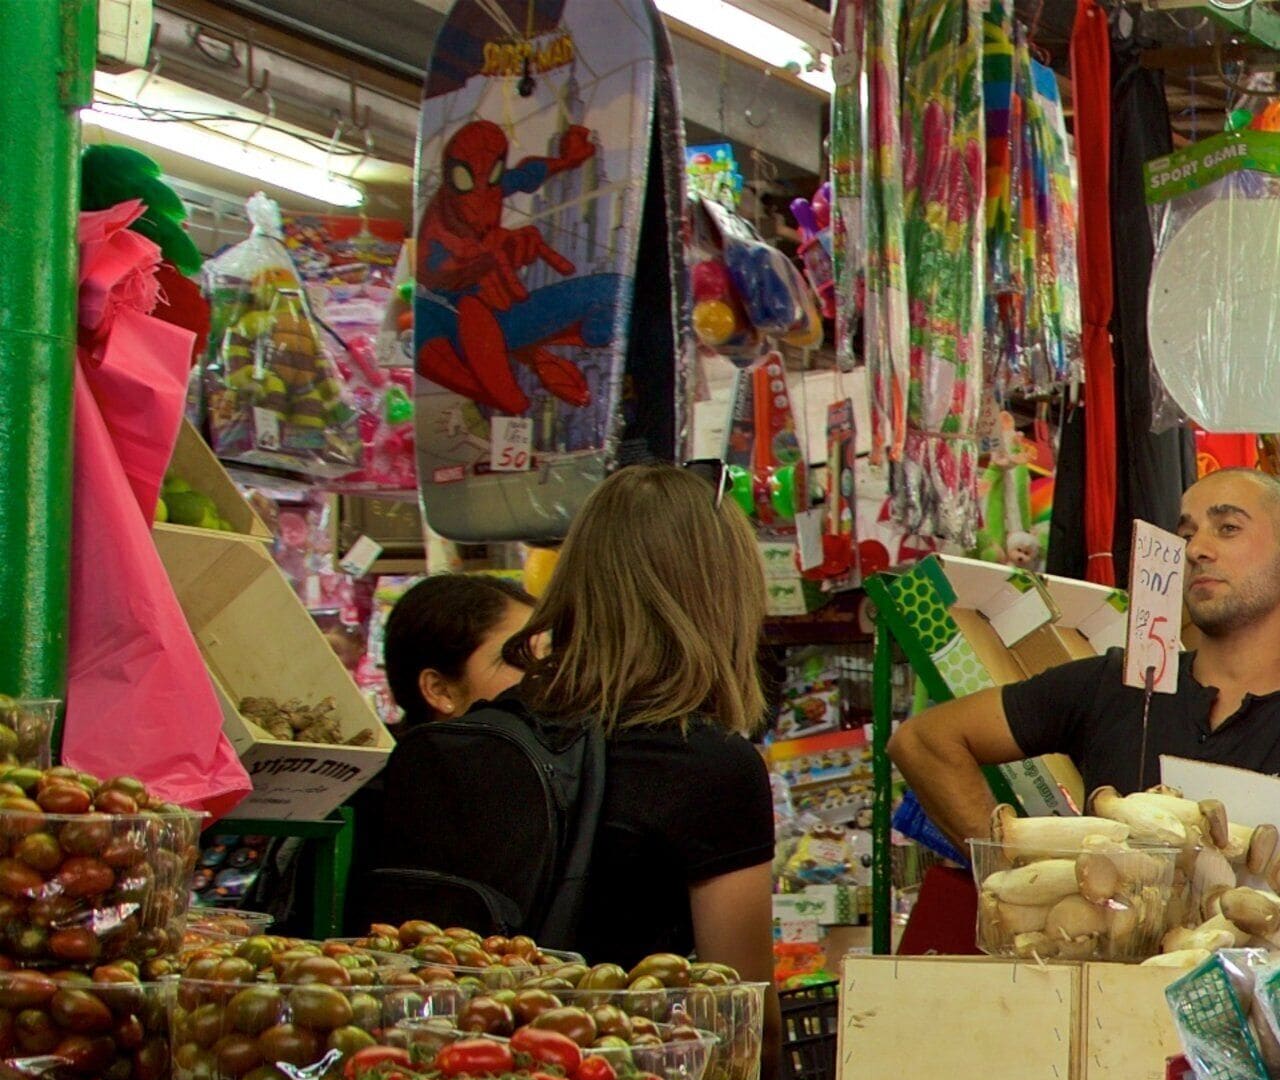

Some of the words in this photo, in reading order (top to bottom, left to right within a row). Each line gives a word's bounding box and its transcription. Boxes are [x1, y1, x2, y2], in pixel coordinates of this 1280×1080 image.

[1150, 160, 1198, 189] SPORT
[1203, 143, 1248, 168] GAME
[499, 446, 528, 468] 50
